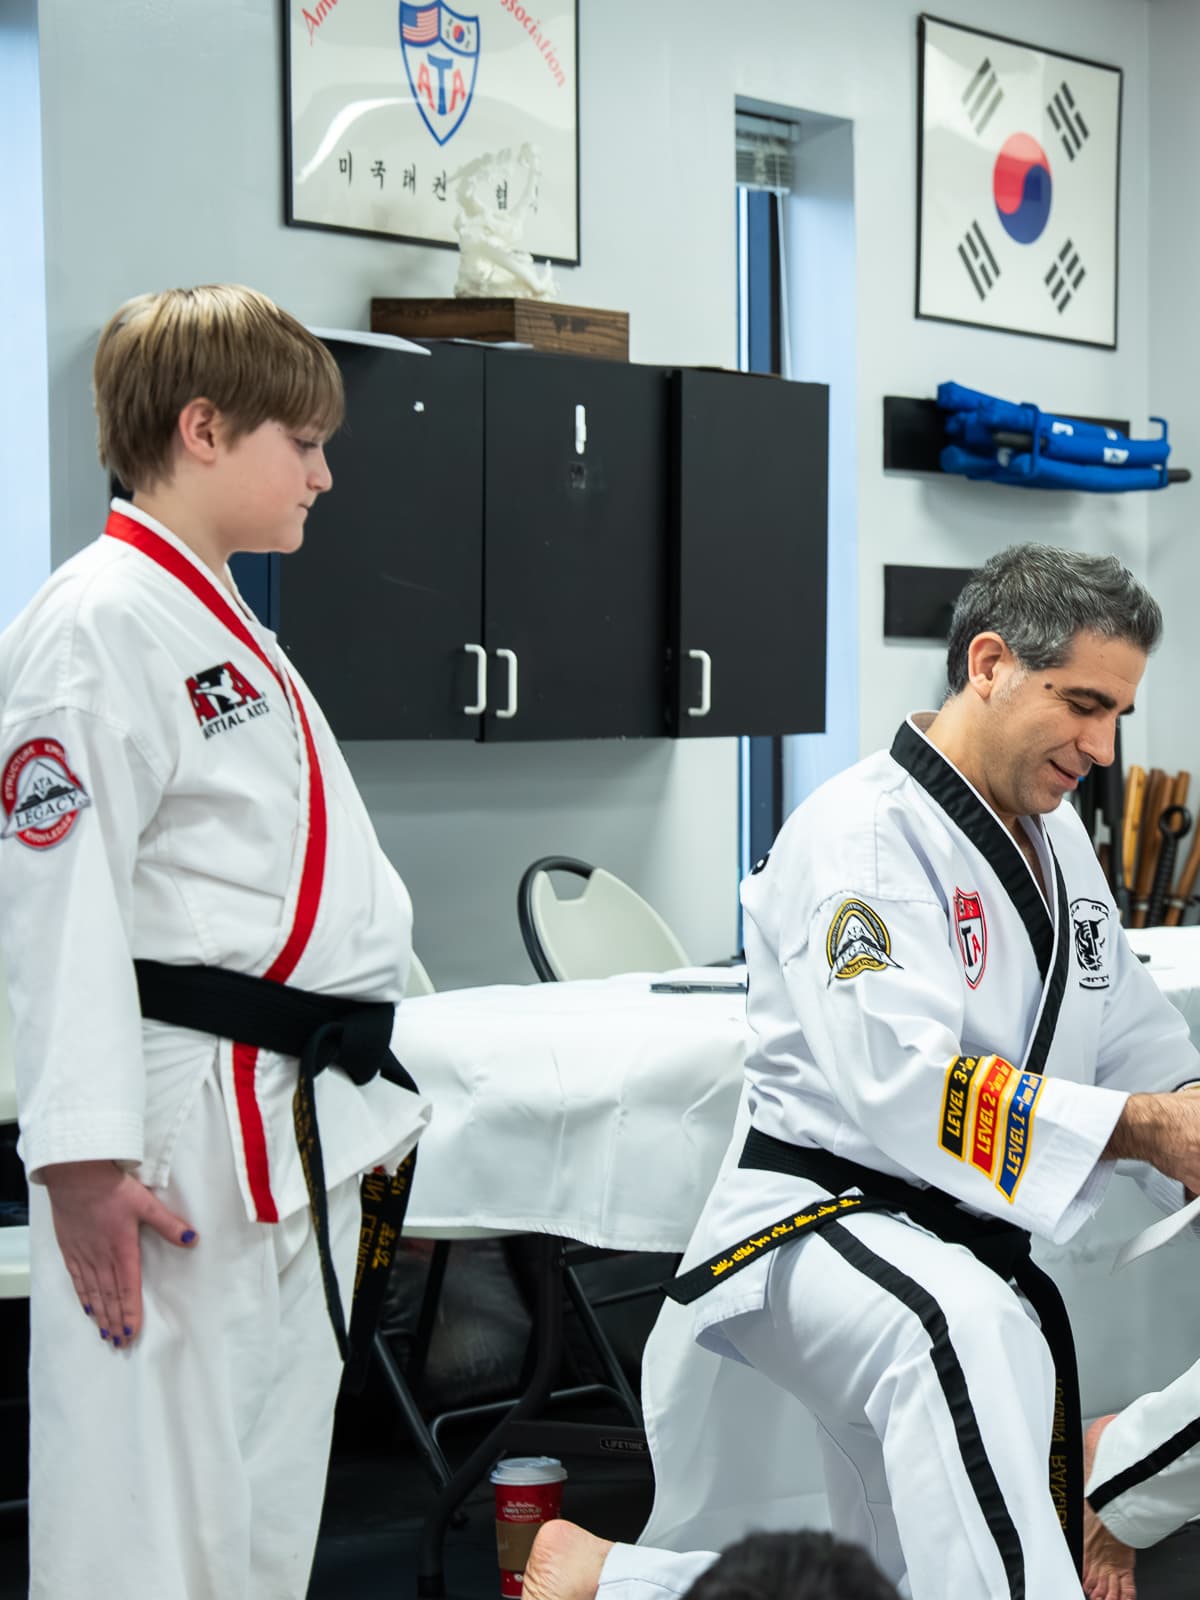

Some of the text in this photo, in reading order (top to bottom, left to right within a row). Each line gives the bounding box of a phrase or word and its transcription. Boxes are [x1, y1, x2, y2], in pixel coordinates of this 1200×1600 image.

[418, 52, 466, 115] ATA
[203, 701, 270, 740] ARTIAL ARTS
[15, 792, 79, 828] LEGACY
[947, 1089, 964, 1138] LEVEL
[977, 1107, 994, 1155] LEVEL
[1007, 1126, 1026, 1176] LEVEL
